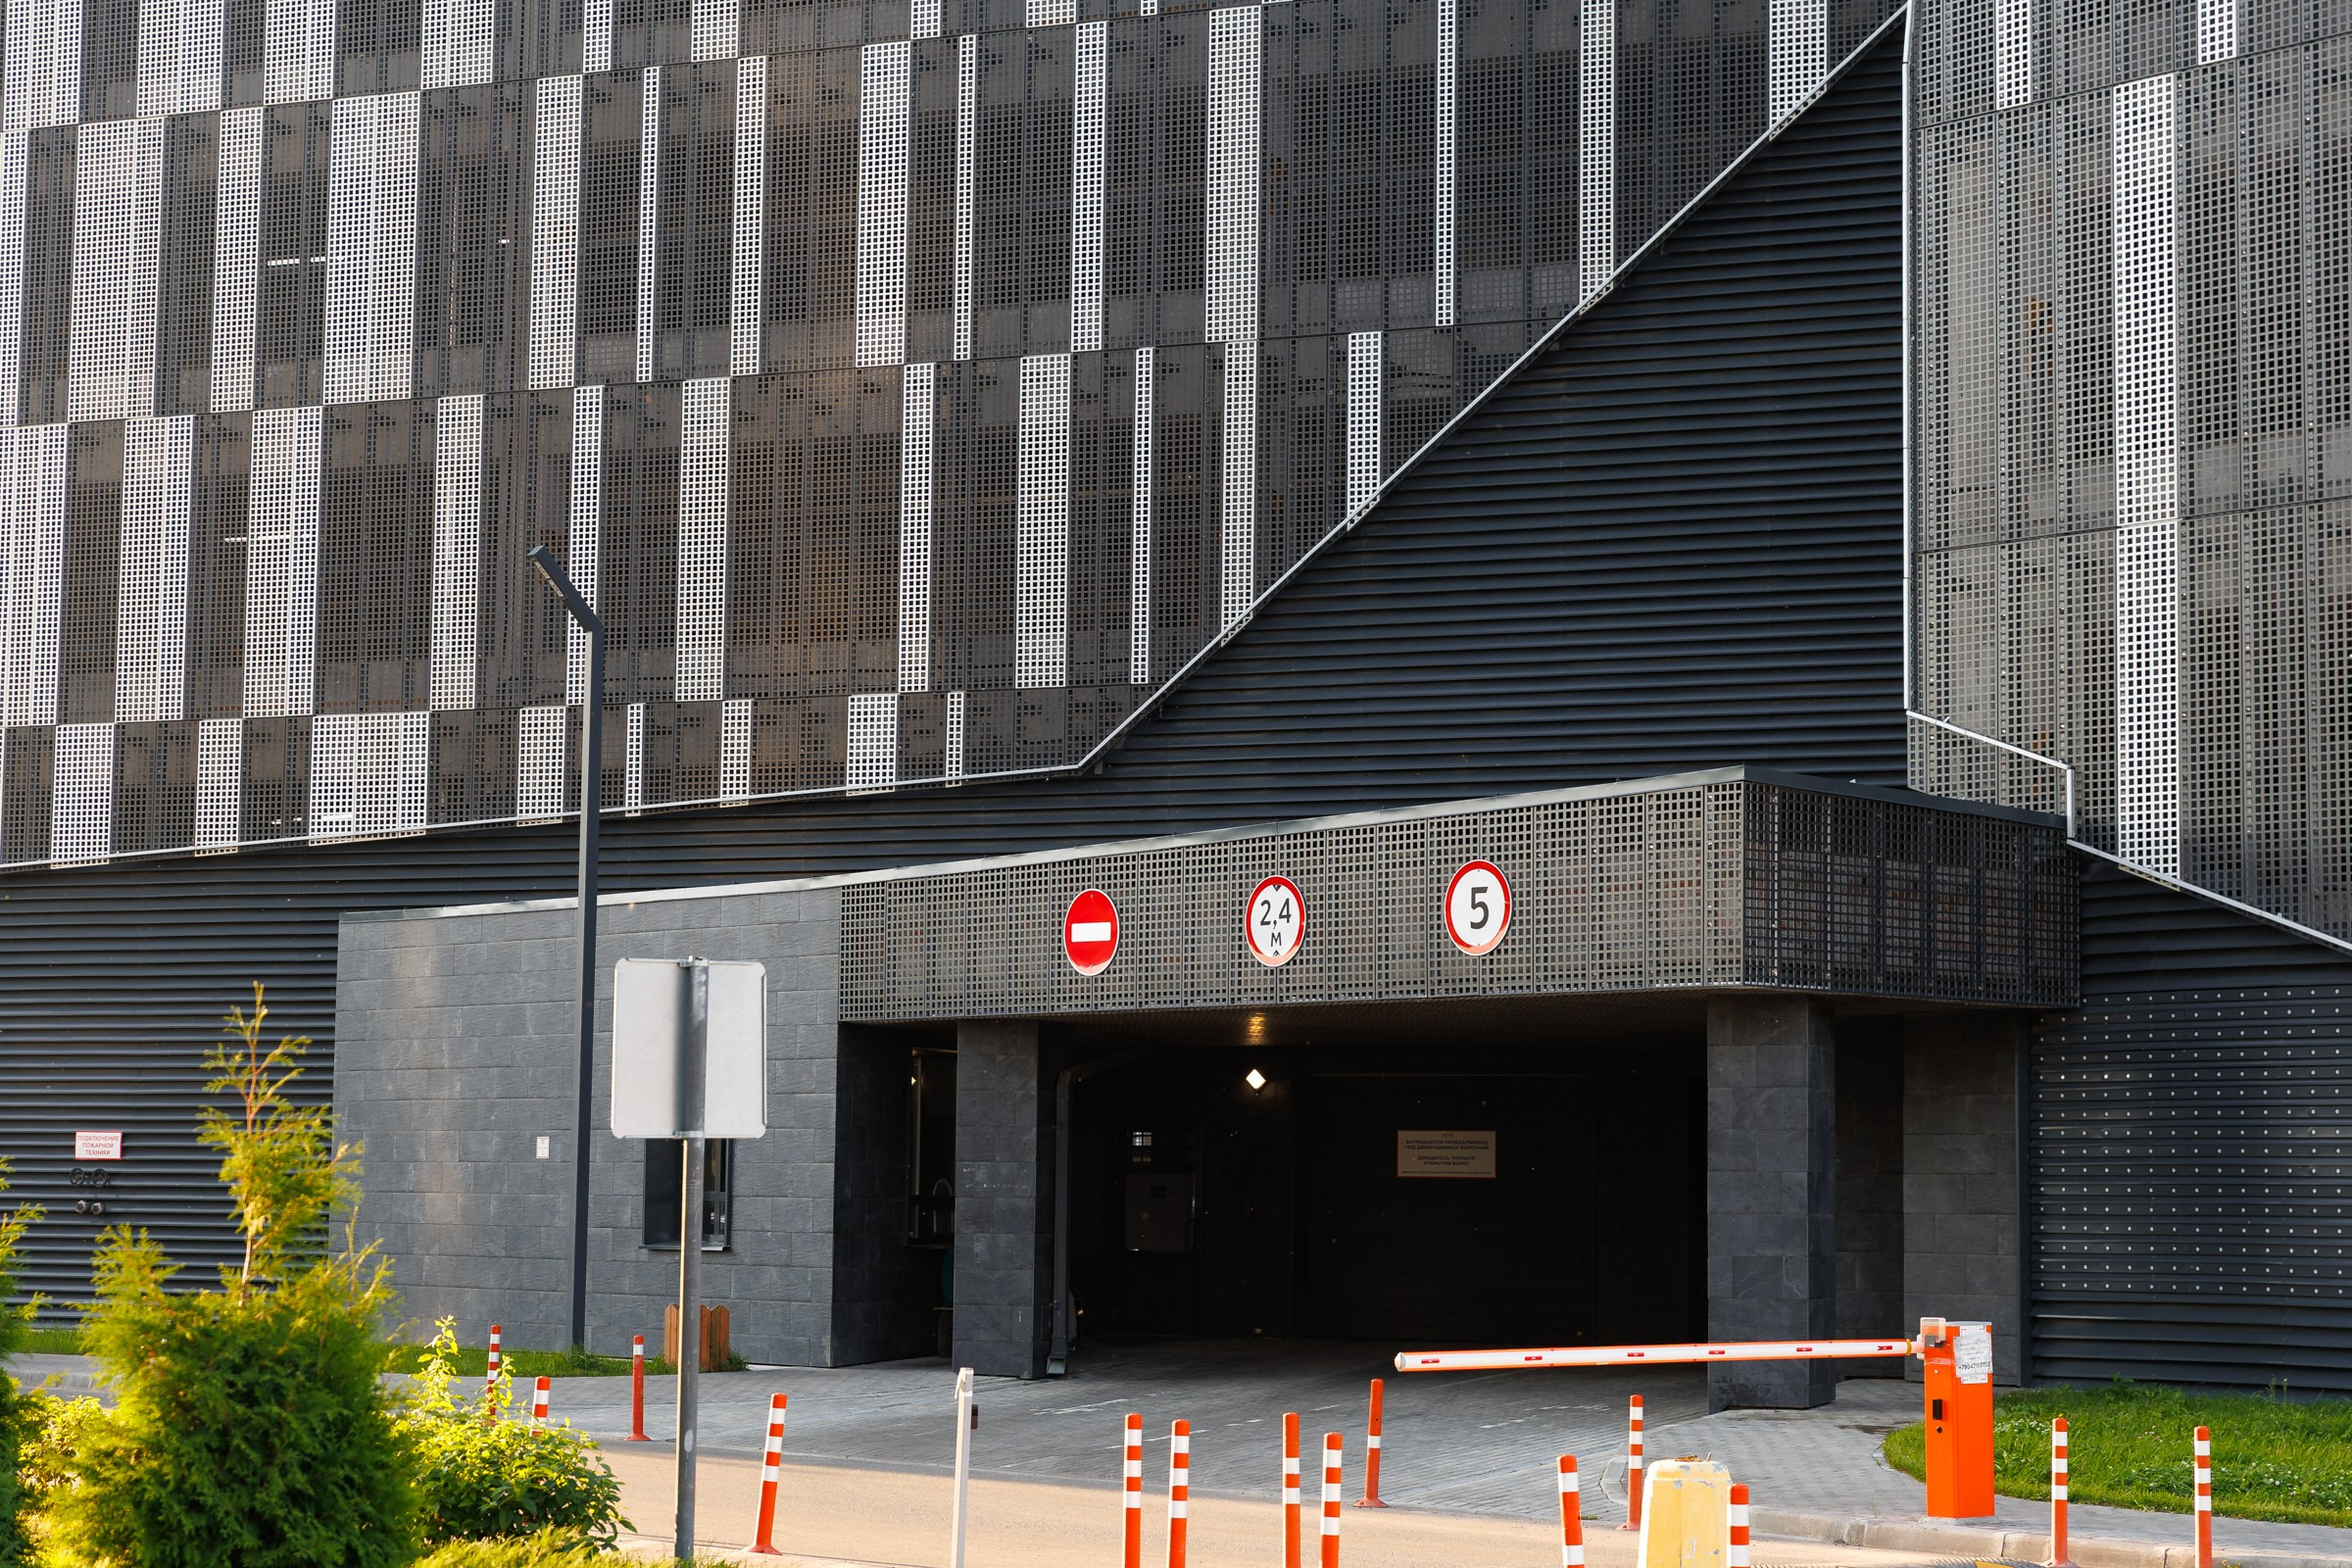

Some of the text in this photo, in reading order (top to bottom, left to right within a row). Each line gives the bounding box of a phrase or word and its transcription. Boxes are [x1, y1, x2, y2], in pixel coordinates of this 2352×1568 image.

[1259, 898, 1292, 929] 2,4
[1470, 886, 1490, 930] 5
[1270, 932, 1282, 947] М
